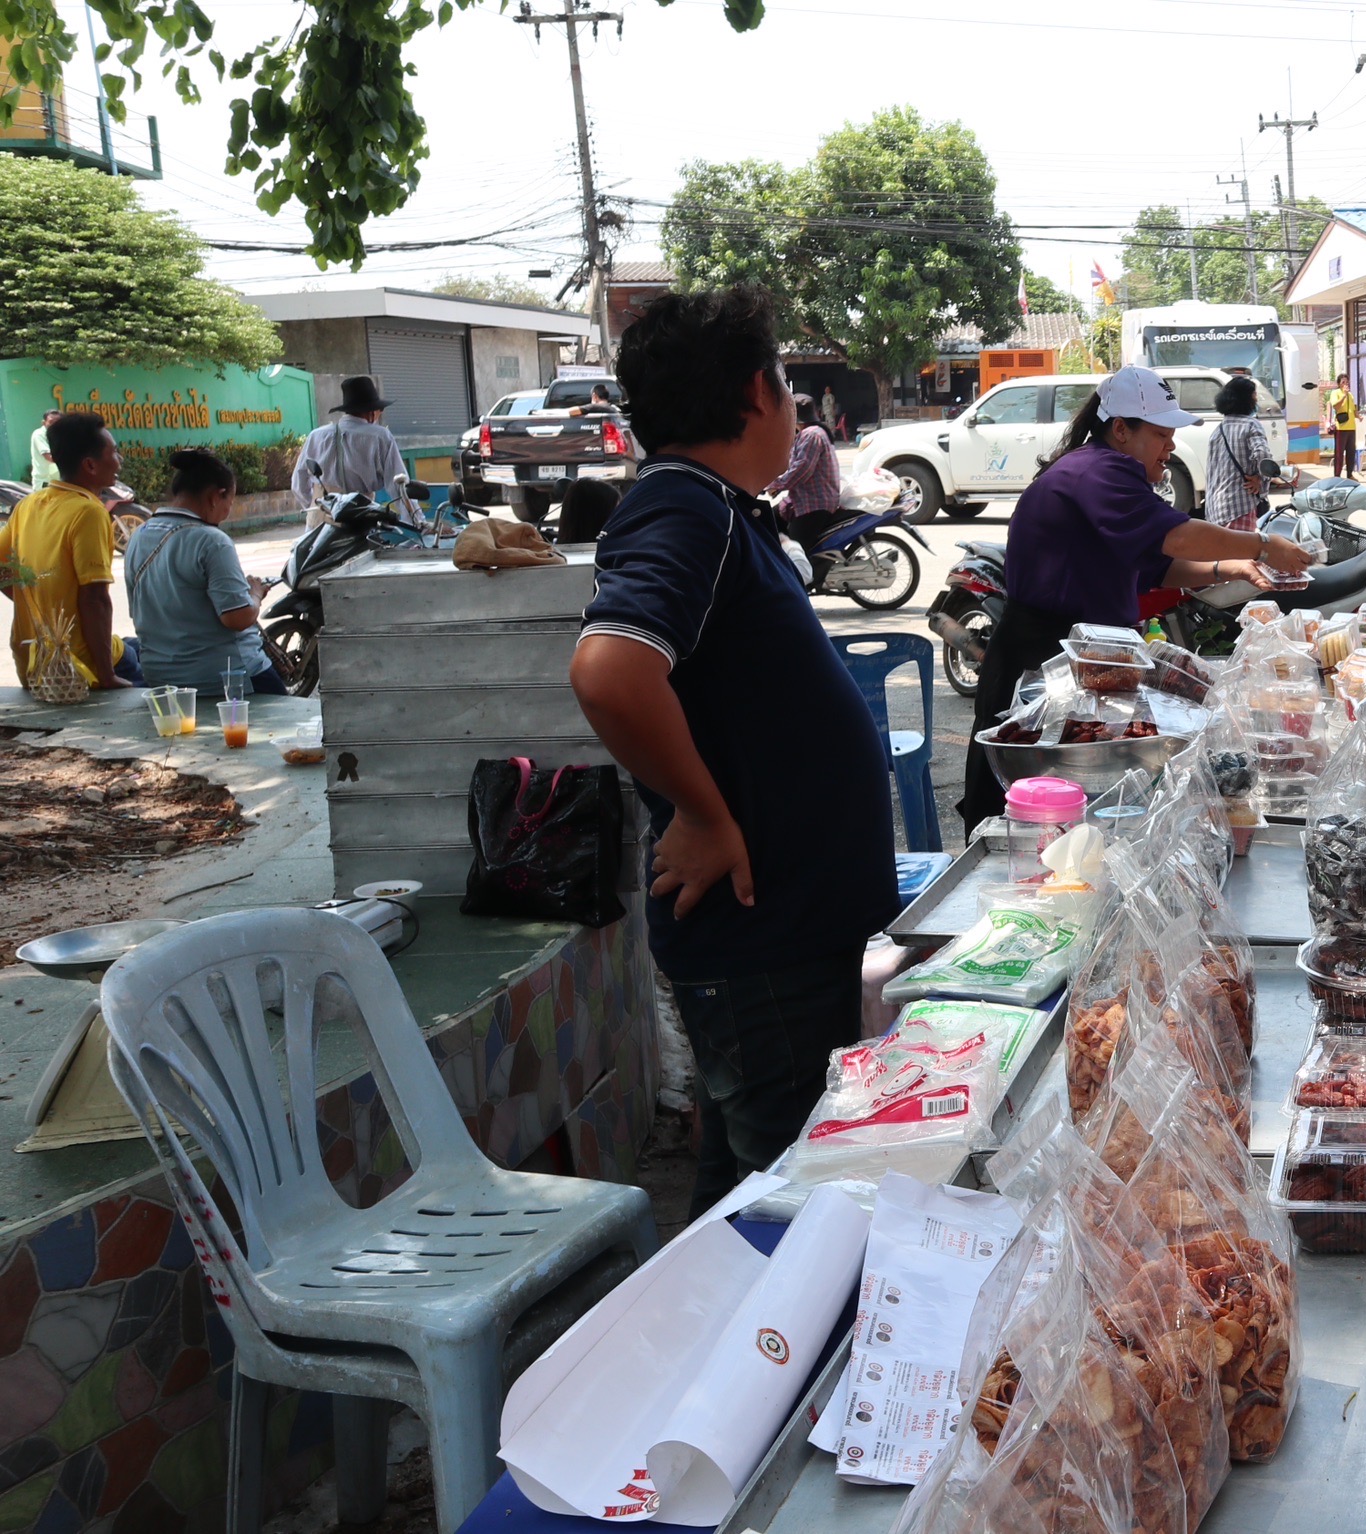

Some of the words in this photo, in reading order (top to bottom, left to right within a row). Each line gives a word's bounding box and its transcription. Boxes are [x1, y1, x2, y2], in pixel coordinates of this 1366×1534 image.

[1153, 327, 1265, 344] รถเอกซเรย์เคลื่อนที่
[930, 1370, 947, 1399] กล้วยตาก
[922, 1408, 940, 1439] กล้วยตาก
